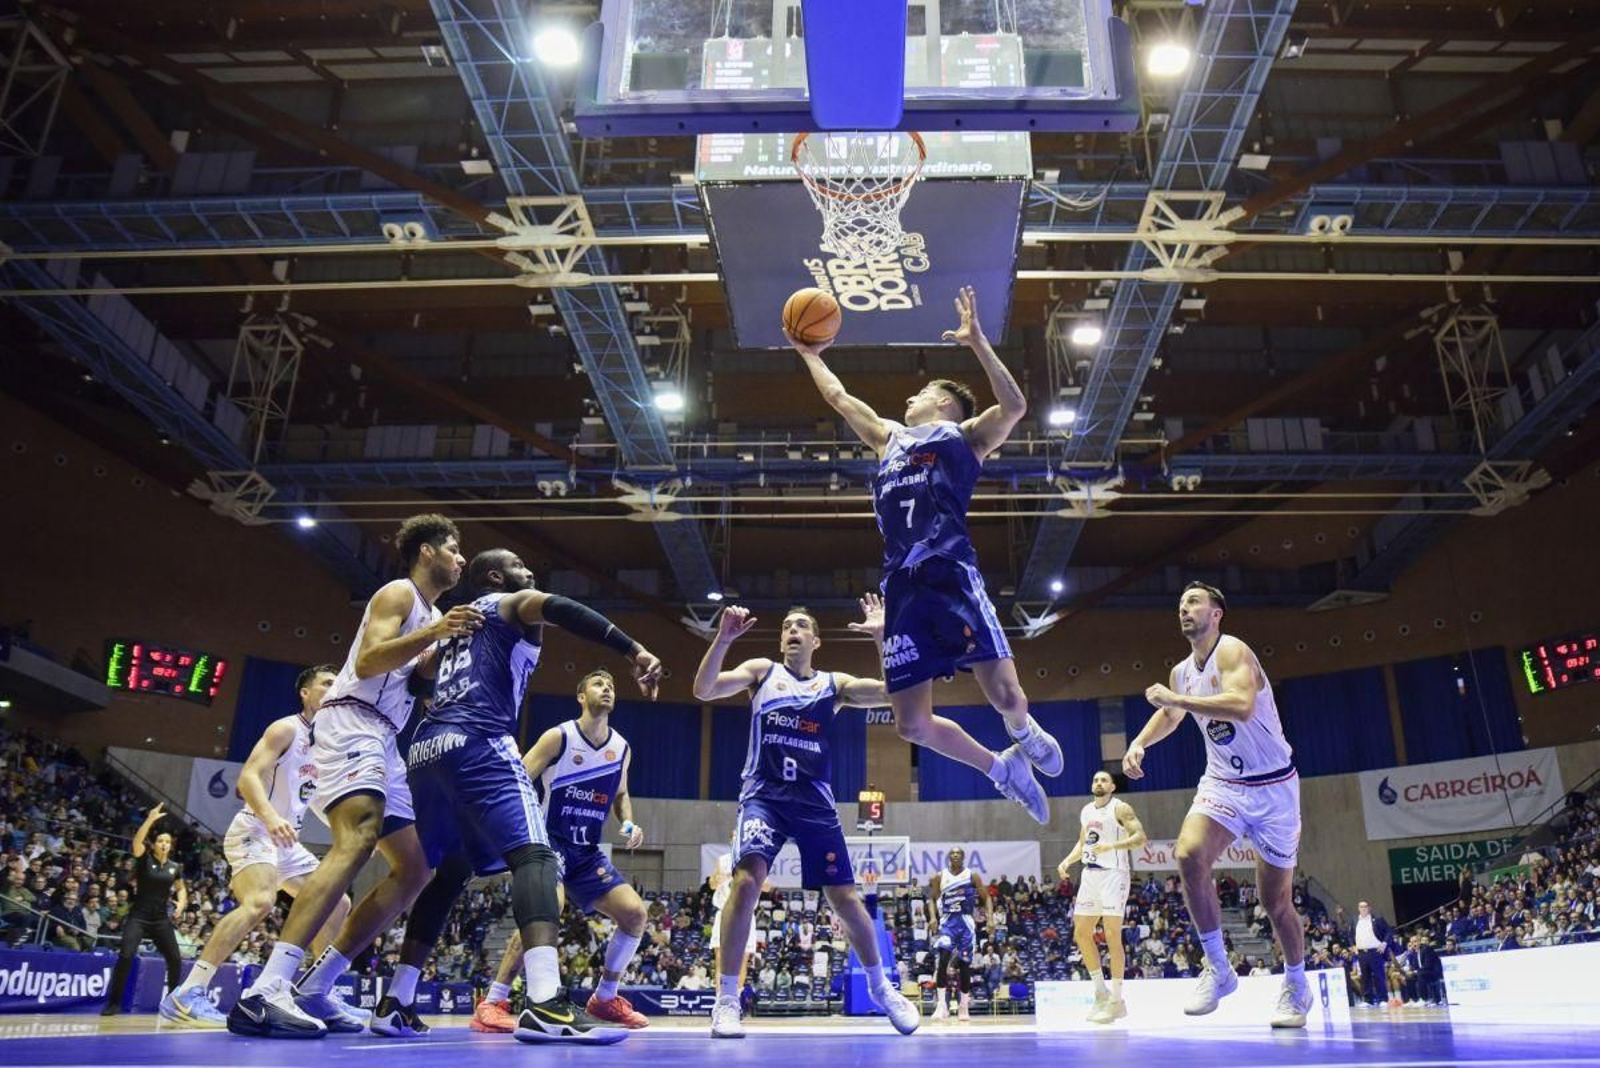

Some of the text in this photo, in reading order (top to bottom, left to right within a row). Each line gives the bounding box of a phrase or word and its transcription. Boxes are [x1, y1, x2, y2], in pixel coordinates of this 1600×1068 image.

[901, 232, 930, 272] CAB
[900, 498, 915, 529] 7
[884, 647, 920, 669] OHNS
[767, 711, 820, 733] Flexicar
[783, 756, 797, 781] 8
[1231, 755, 1244, 775] 9
[565, 785, 609, 805] Flexica
[871, 803, 881, 818] 5
[860, 850, 987, 876] ABANA
[1139, 843, 1166, 864] La
[1416, 842, 1480, 863] SAIDA
